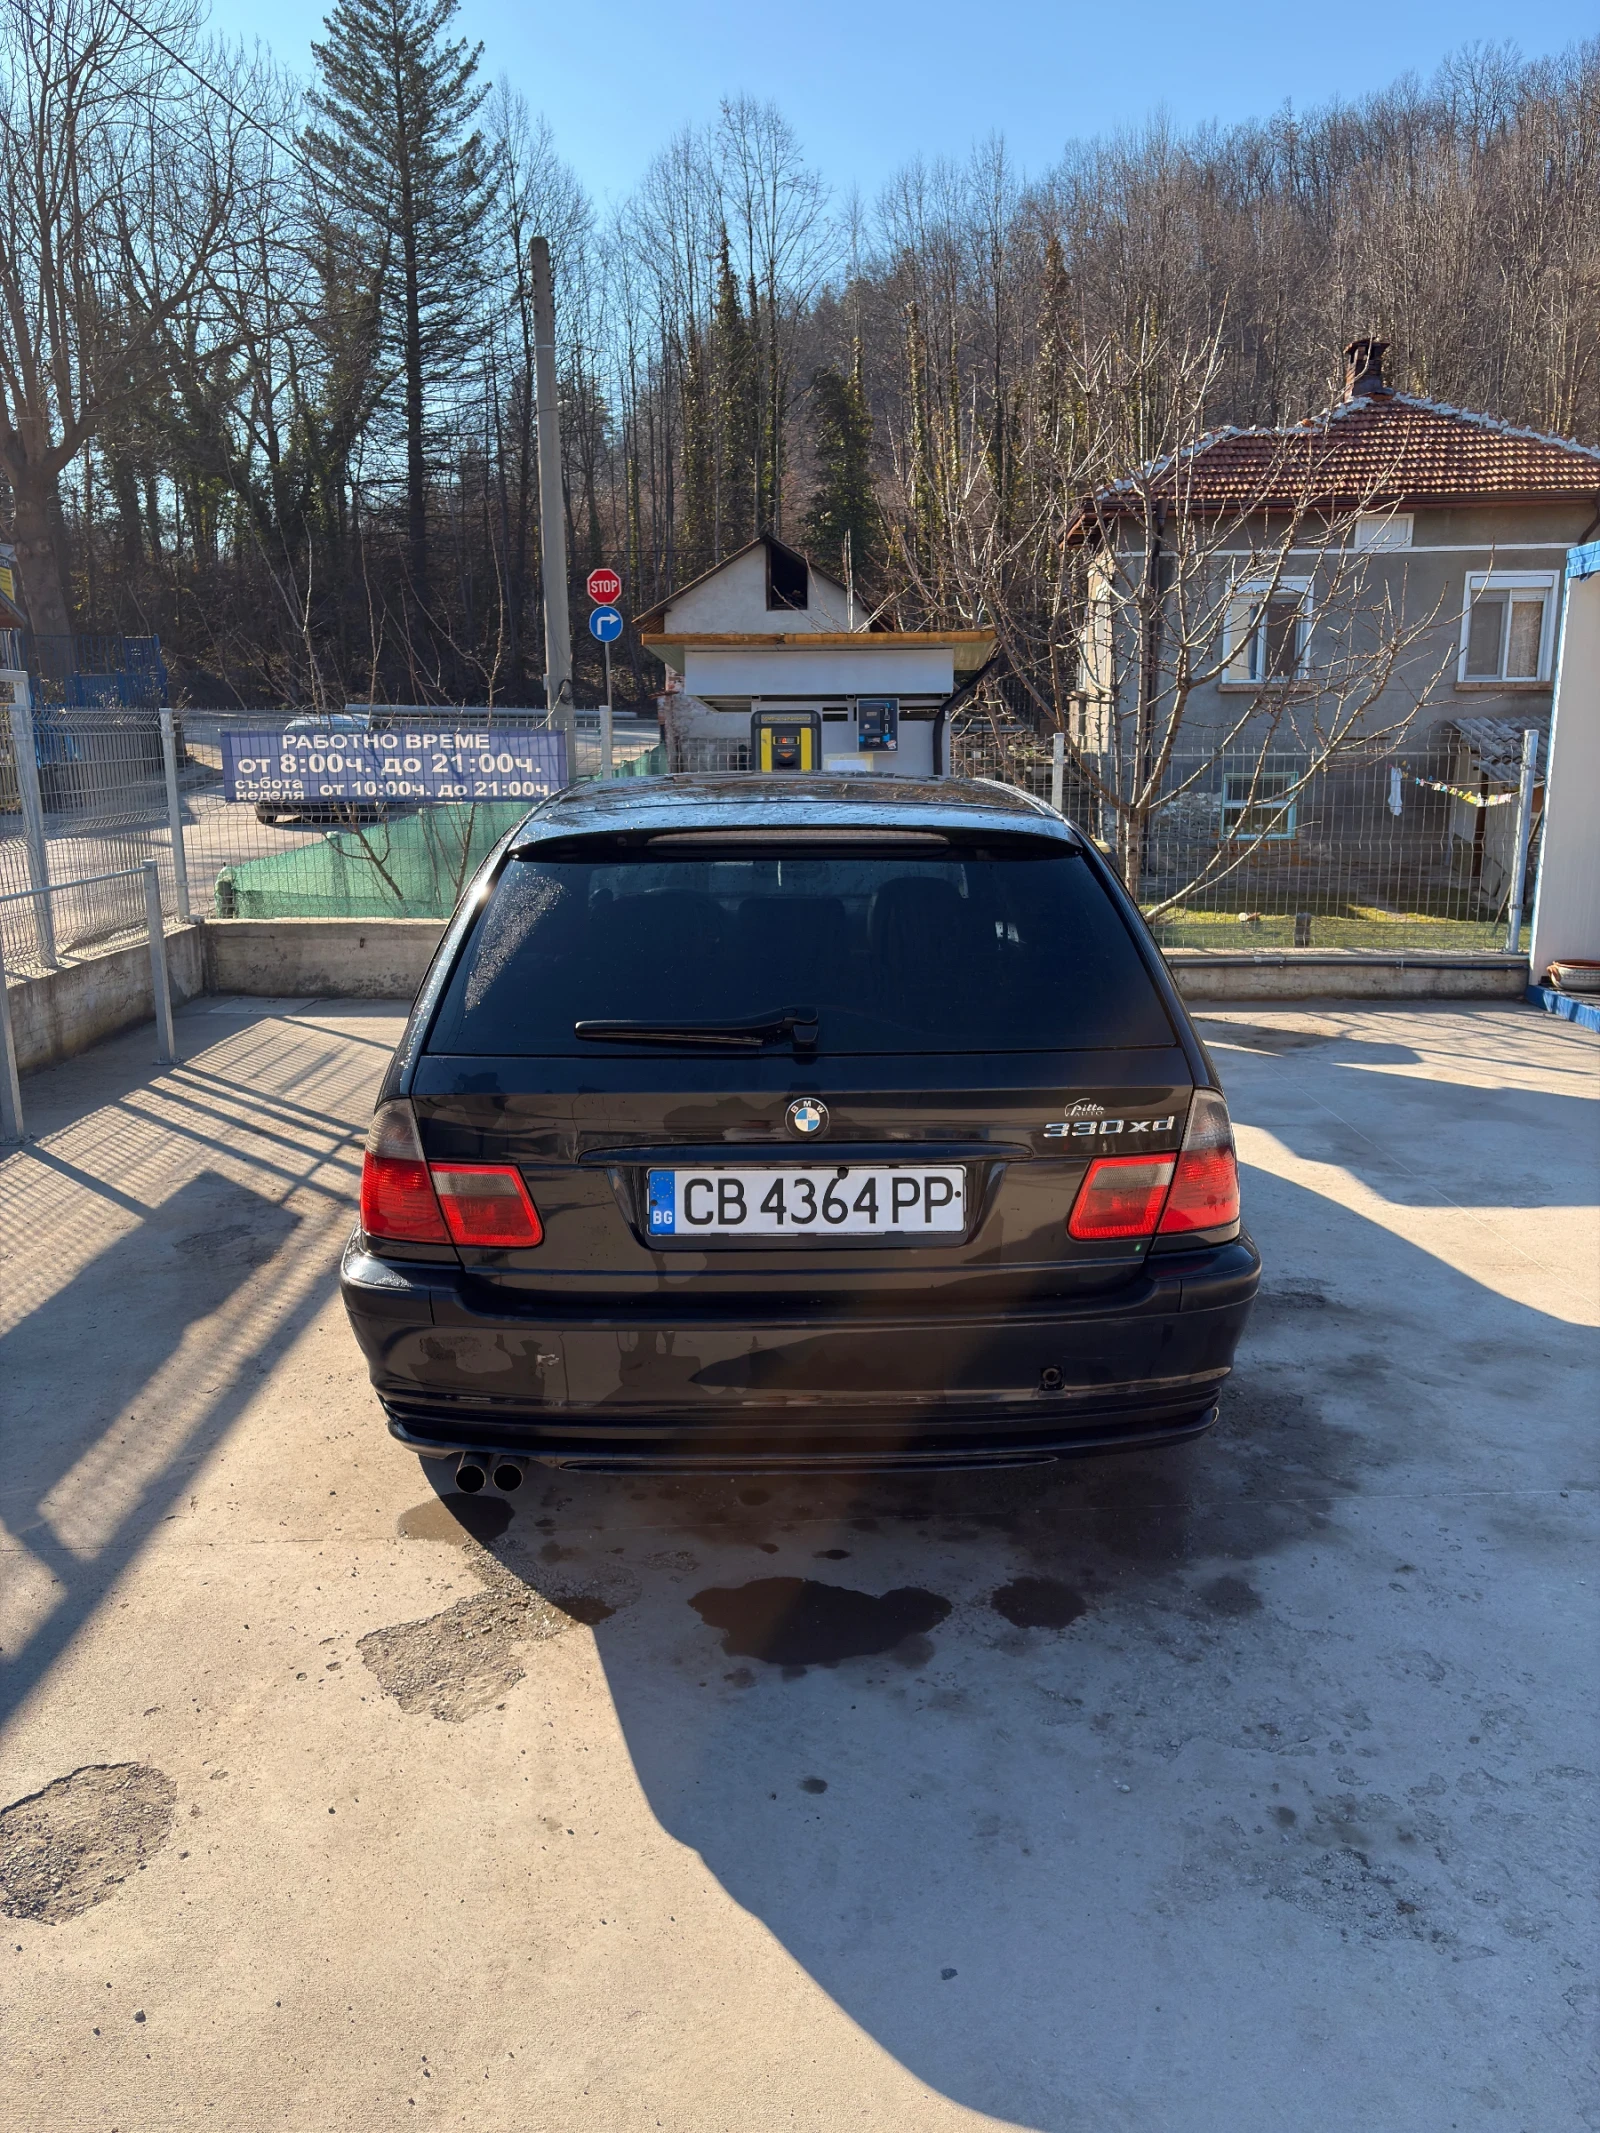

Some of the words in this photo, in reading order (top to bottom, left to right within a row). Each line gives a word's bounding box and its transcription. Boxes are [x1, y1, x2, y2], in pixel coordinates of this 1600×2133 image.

[591, 580, 618, 593] STOP
[282, 734, 398, 749] РАБОТНО
[406, 734, 490, 749] ВРЕМЕ
[238, 758, 271, 774] от
[280, 753, 371, 773] 8:00ч.
[381, 758, 422, 776] до
[431, 753, 542, 773] 21:00ч.
[235, 776, 304, 789] събота
[319, 784, 345, 796] от
[351, 781, 431, 796] 10:00ч.
[438, 784, 468, 798] до
[236, 790, 305, 801] неделя
[790, 1100, 825, 1114] BMW
[652, 1210, 673, 1224] BG
